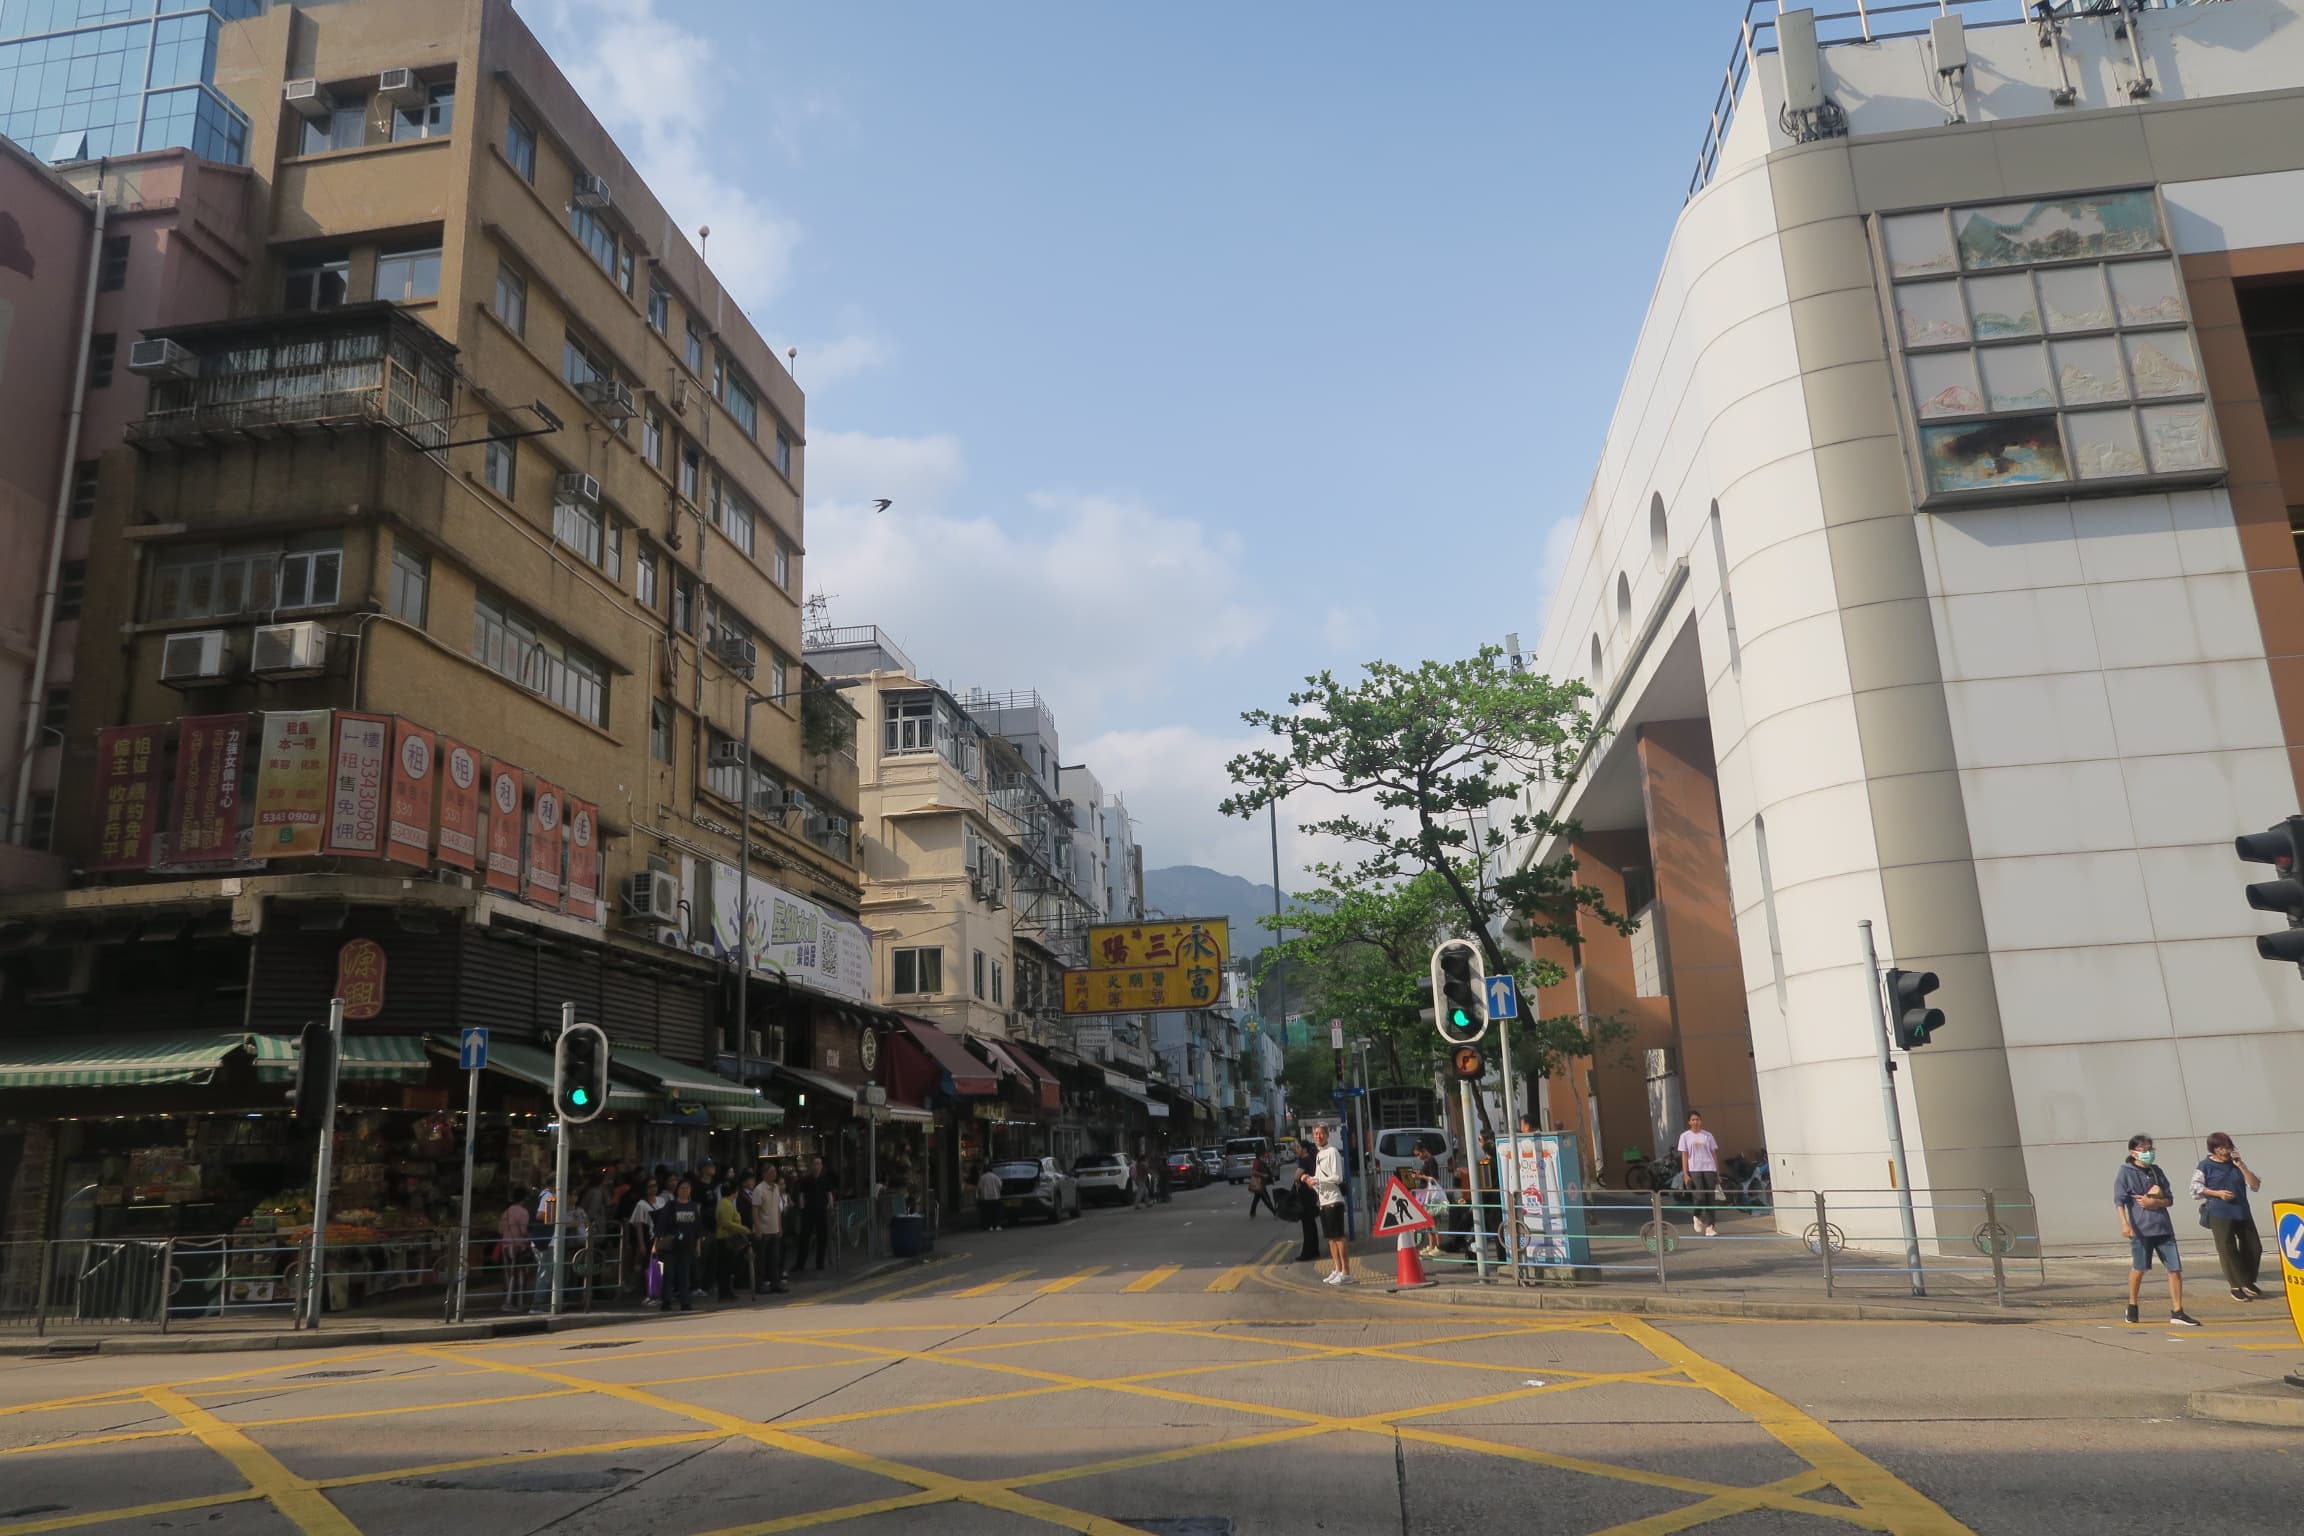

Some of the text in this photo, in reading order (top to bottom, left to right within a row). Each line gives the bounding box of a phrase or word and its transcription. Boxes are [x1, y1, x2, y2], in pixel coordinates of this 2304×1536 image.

[336, 752, 358, 840] 租售免佣
[409, 744, 423, 772] 租
[456, 755, 469, 783] 租
[356, 758, 379, 841] 53430908
[1183, 925, 1217, 1001] 永富
